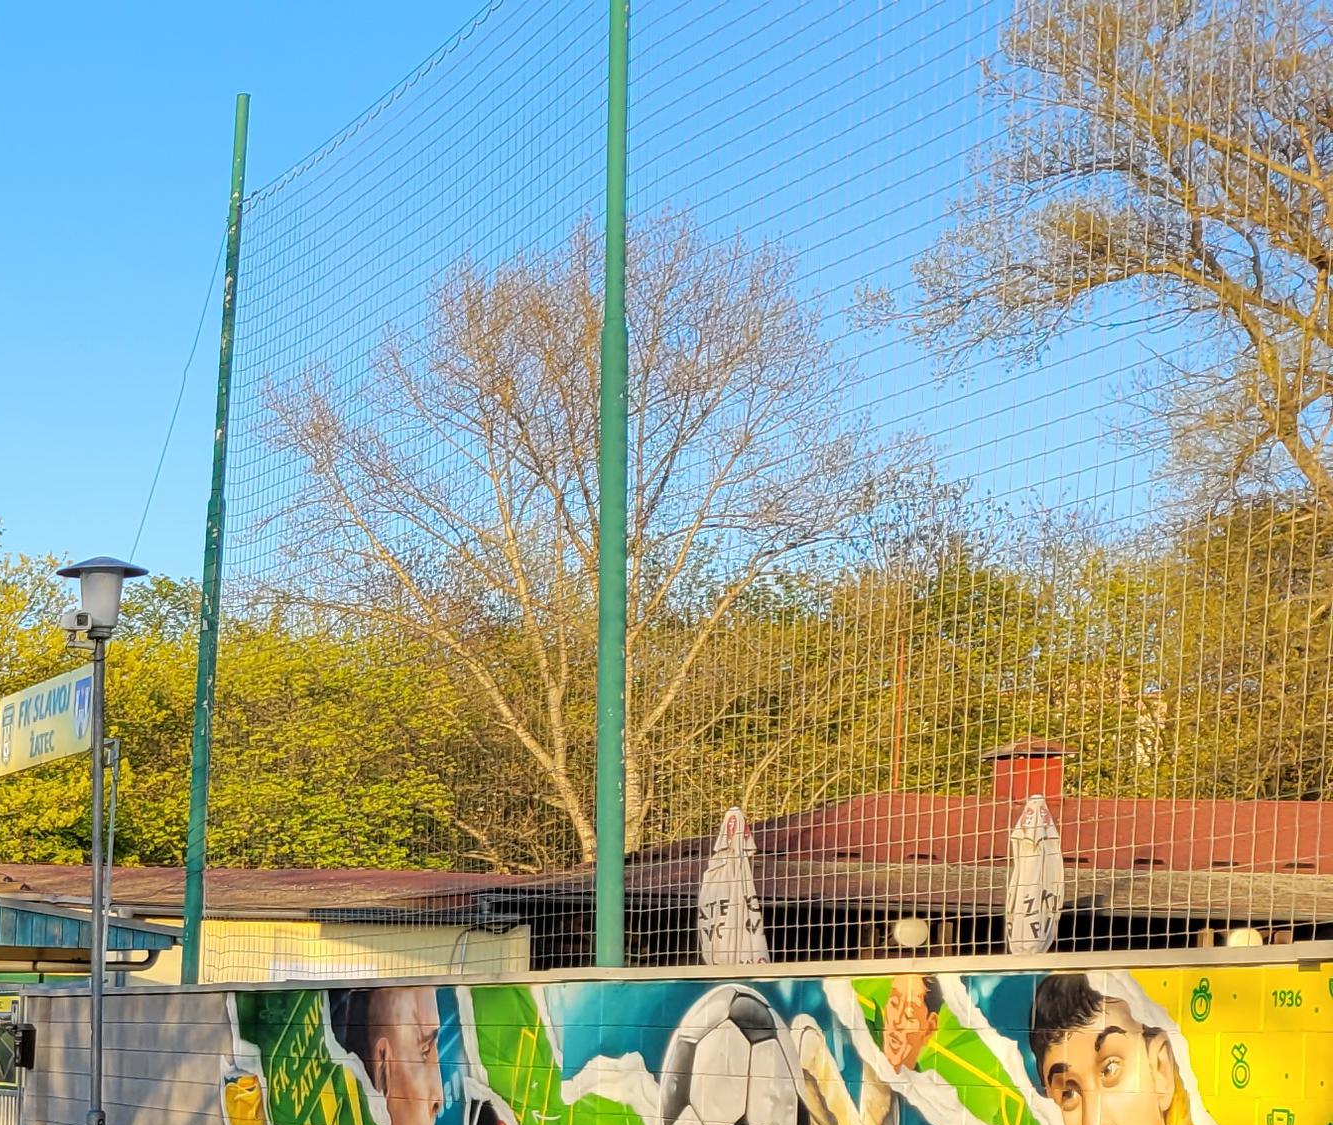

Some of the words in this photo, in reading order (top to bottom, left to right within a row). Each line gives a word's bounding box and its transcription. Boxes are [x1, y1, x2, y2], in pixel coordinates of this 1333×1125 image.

[18, 697, 31, 729] FK
[33, 682, 71, 723] SLAVOJ
[29, 729, 55, 758] ŽATEC
[1271, 989, 1303, 1008] 1936
[273, 1057, 290, 1106] FK
